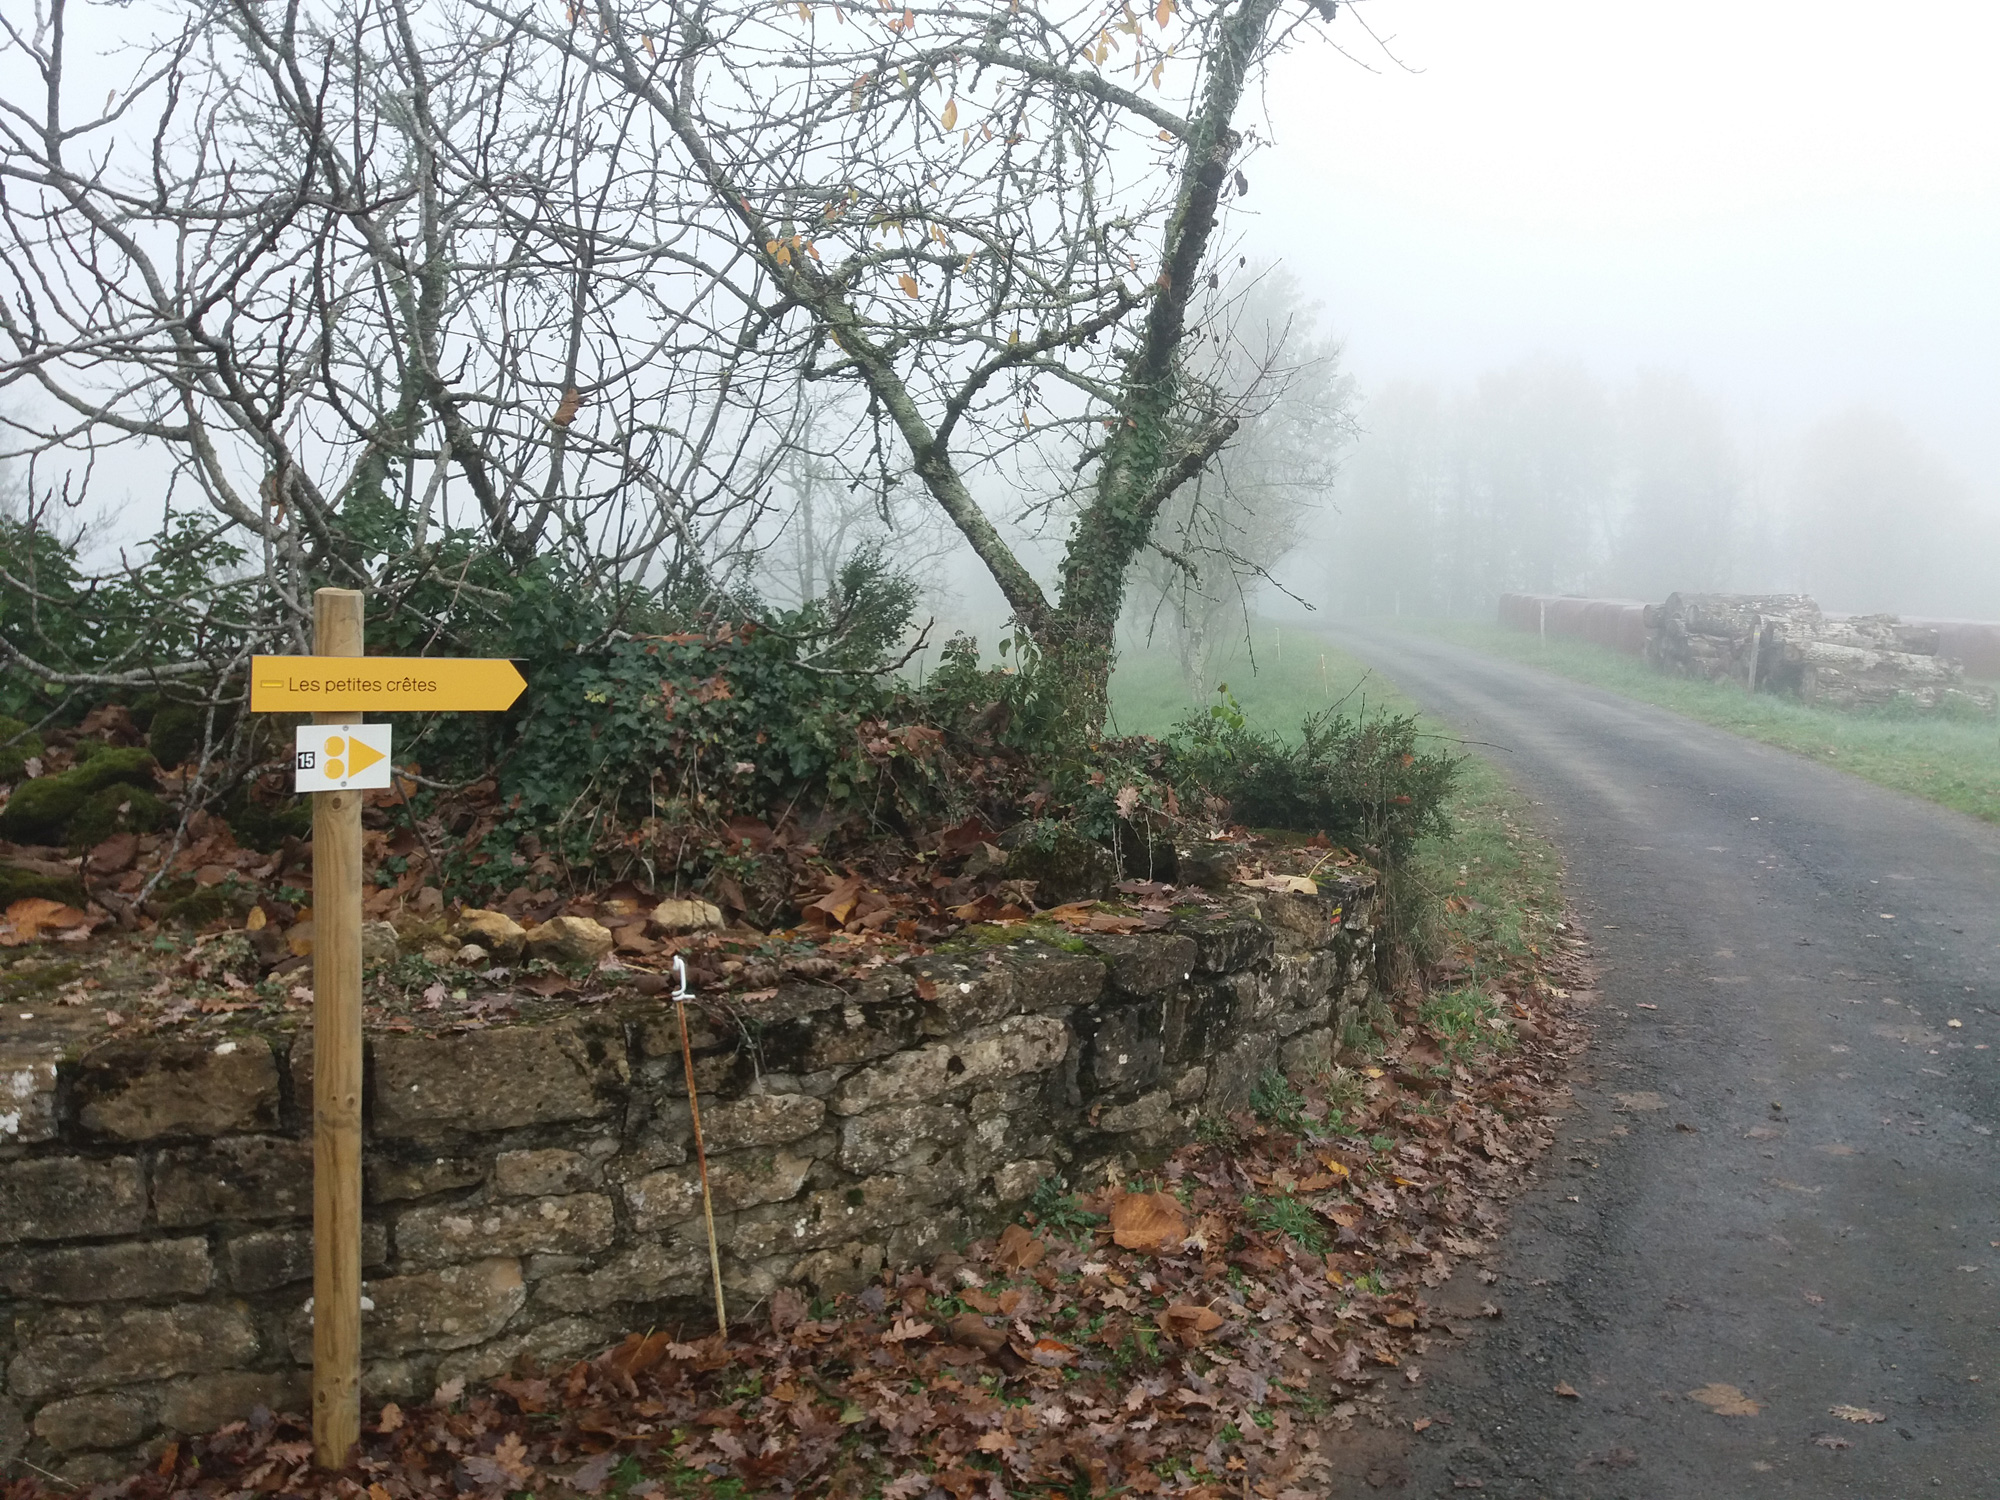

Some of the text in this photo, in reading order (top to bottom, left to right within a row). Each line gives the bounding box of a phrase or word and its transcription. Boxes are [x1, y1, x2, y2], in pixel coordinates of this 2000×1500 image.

[288, 676, 437, 695] Les petites crêtes
[298, 753, 314, 768] 15
